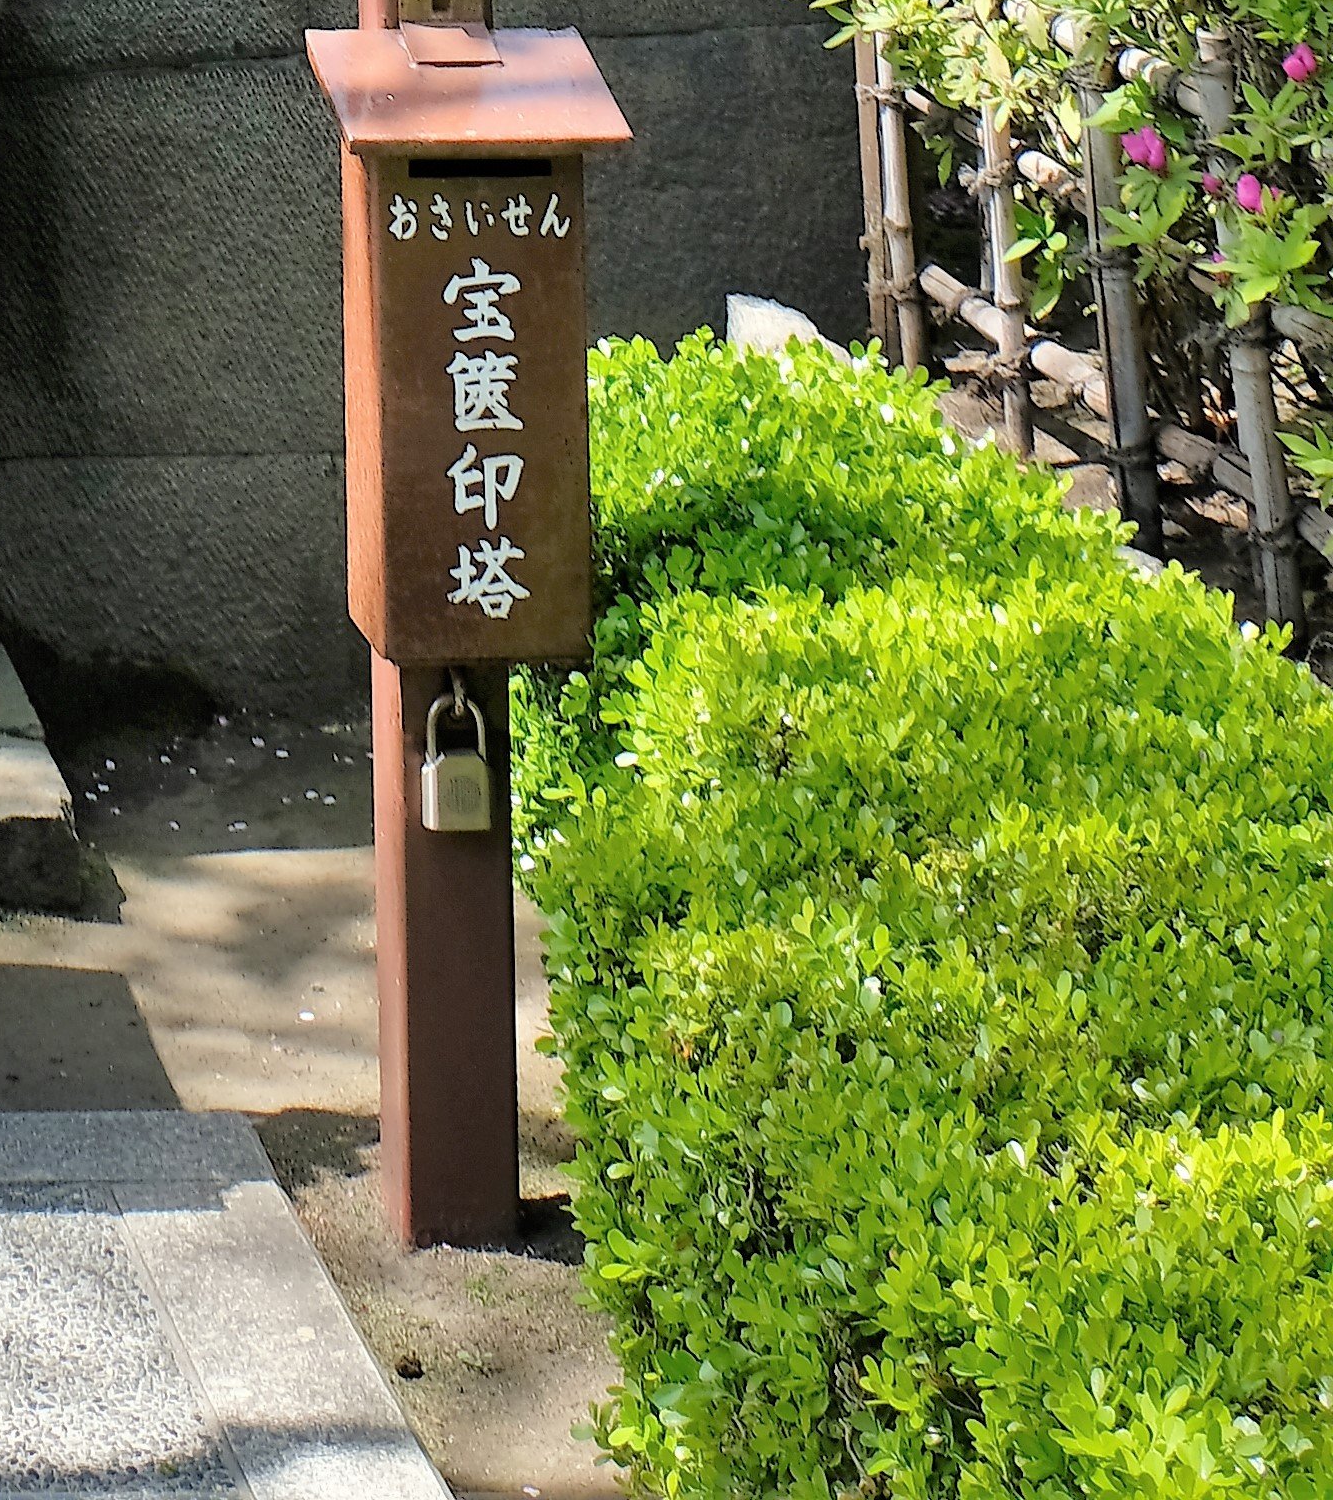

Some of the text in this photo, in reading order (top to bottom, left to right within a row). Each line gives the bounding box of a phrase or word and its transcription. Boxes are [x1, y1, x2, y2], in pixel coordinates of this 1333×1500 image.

[386, 192, 572, 242] おさいせん
[441, 257, 531, 621] 宝篋印塔
